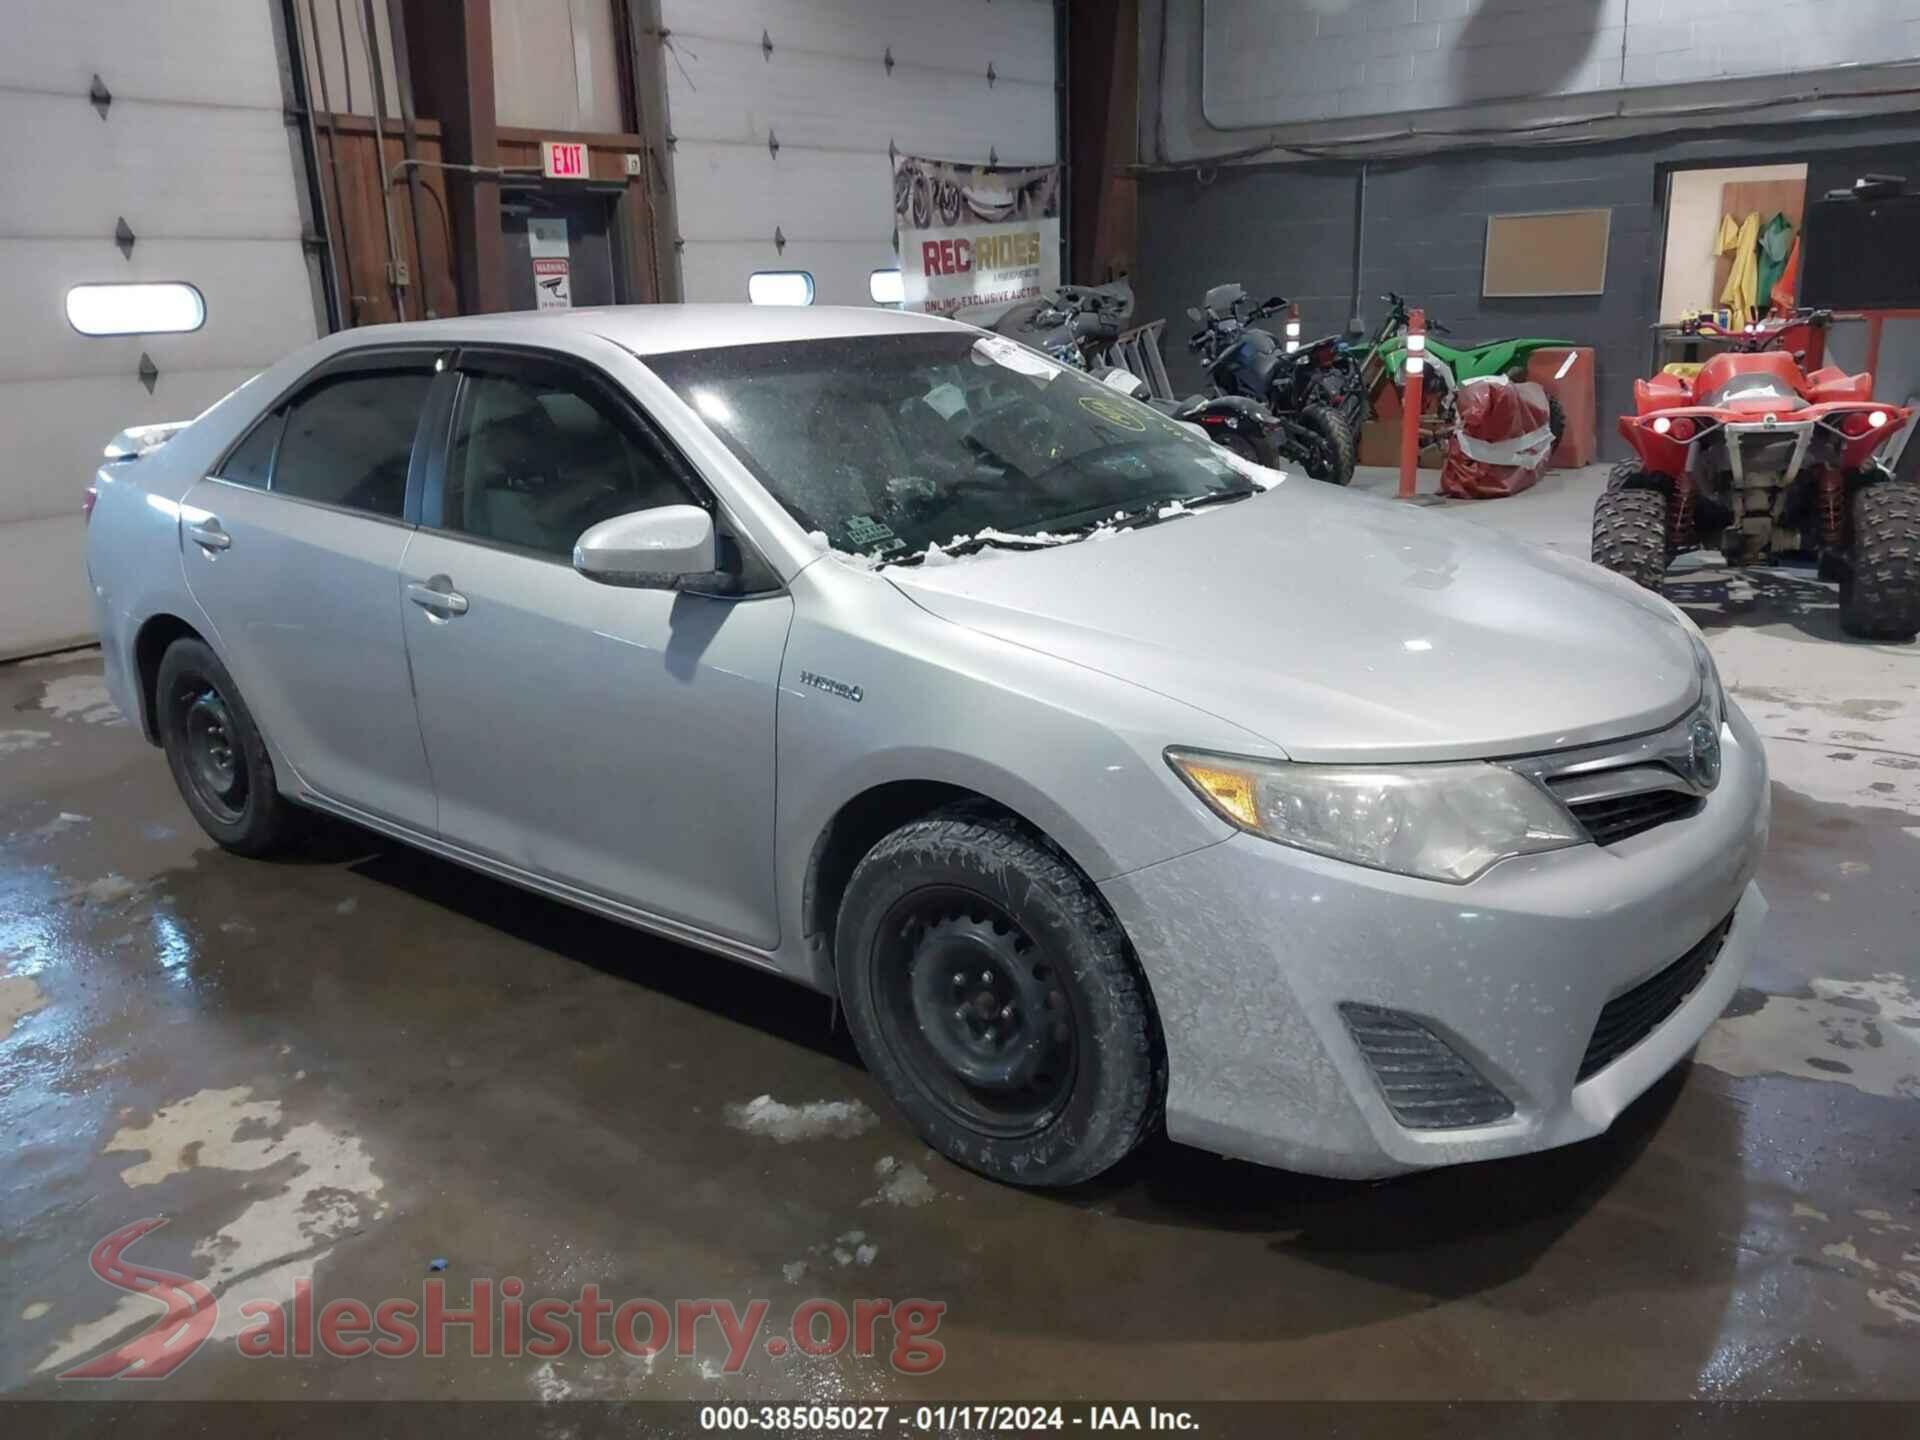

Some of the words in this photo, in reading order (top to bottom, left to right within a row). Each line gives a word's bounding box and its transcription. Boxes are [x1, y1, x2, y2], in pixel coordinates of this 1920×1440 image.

[552, 145, 582, 174] EXIT
[922, 239, 972, 277] REC
[976, 232, 1040, 271] RIDES
